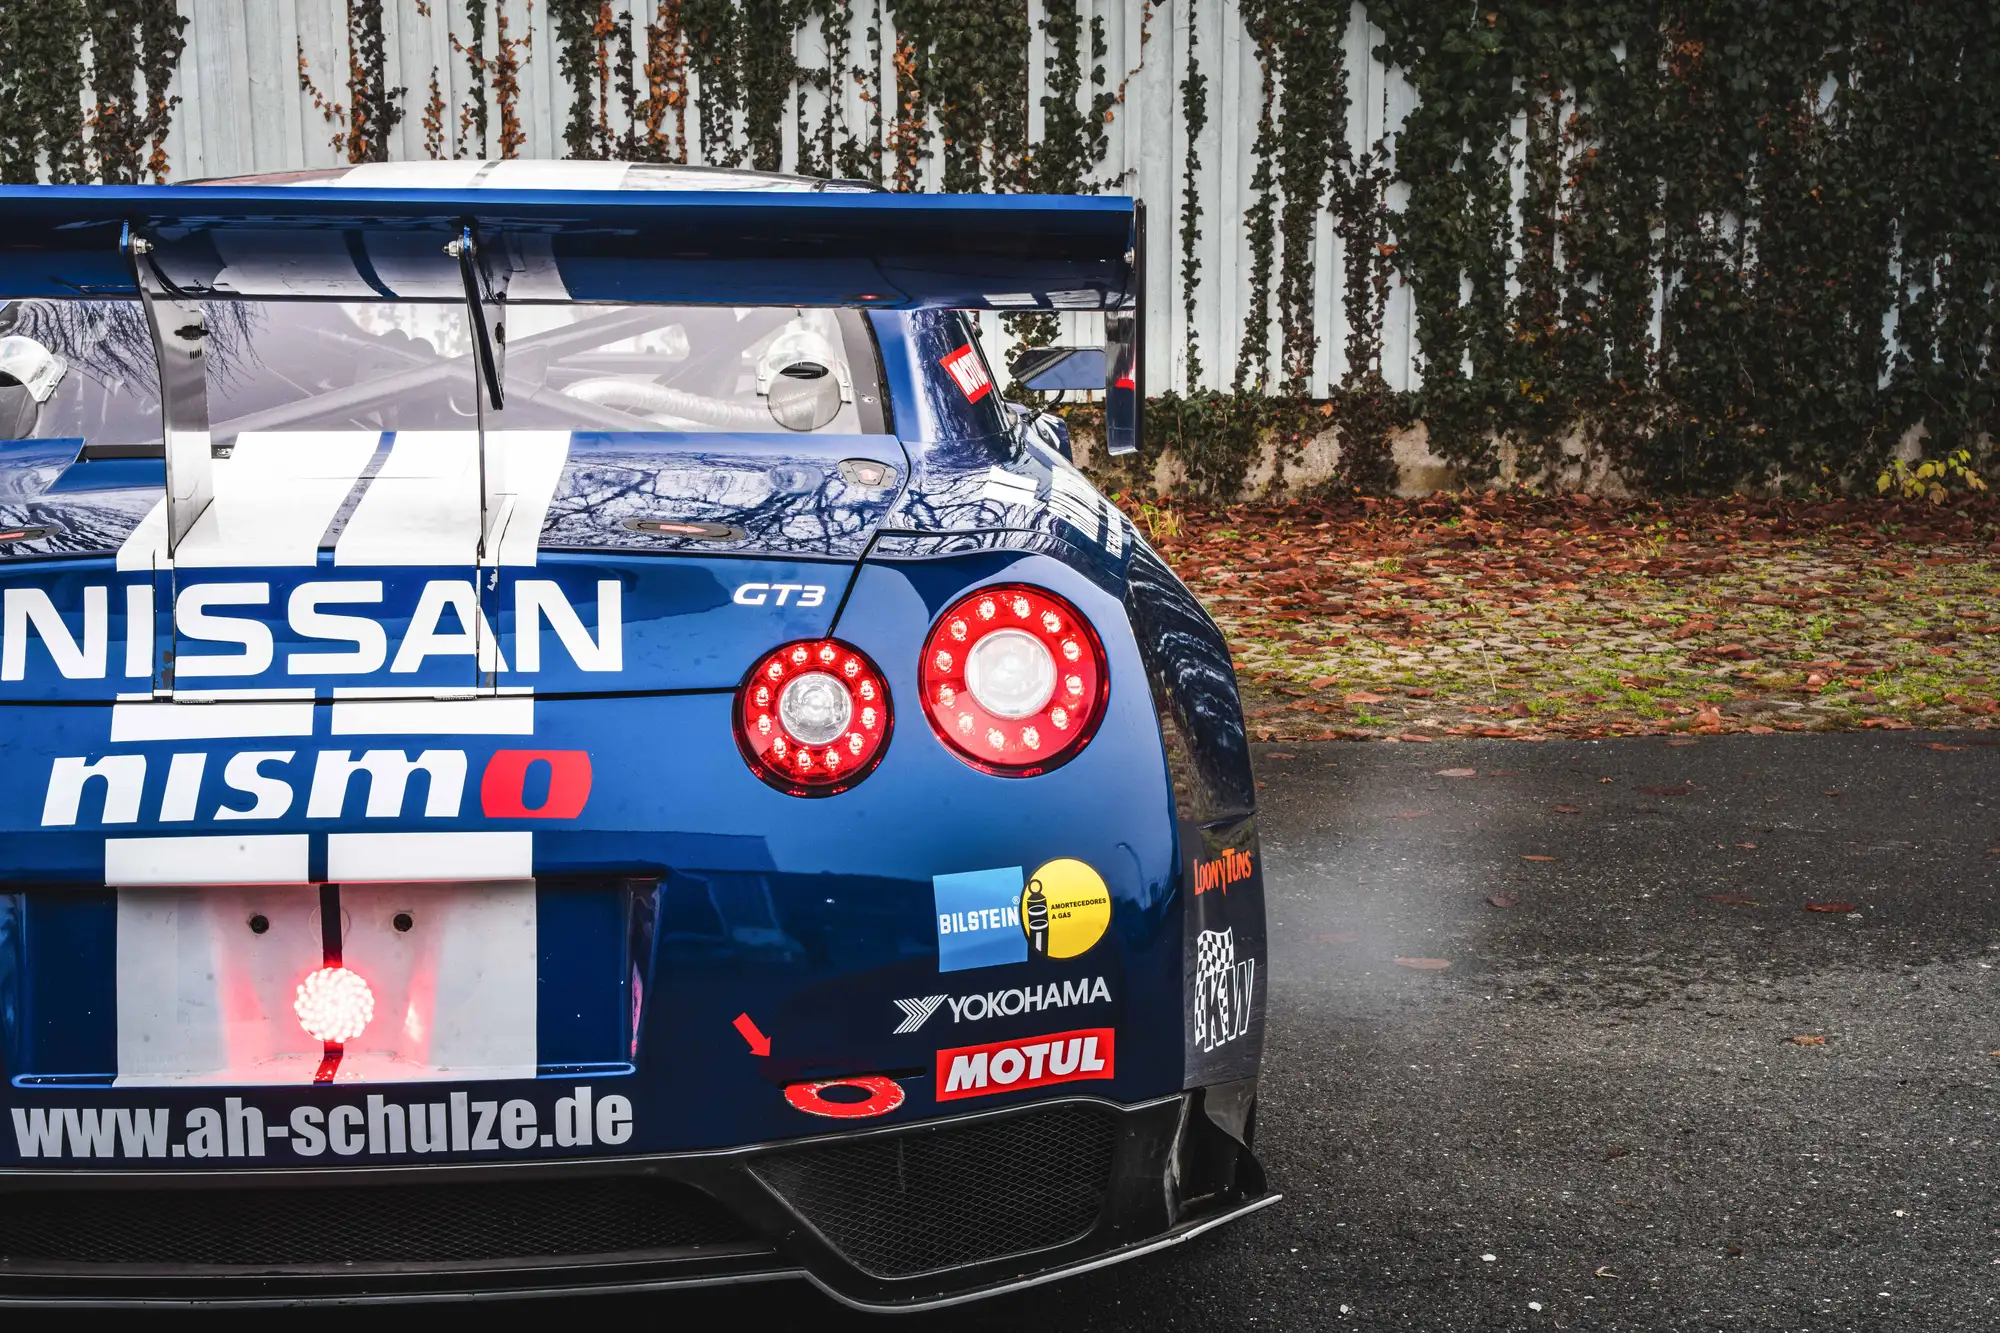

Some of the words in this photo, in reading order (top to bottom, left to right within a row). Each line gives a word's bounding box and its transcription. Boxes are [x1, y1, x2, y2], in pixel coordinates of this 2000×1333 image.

[733, 583, 826, 607] GT3
[1, 580, 623, 681] NISSAN
[41, 749, 593, 826] nismo
[939, 906, 1020, 935] BILSTEIN
[1051, 897, 1107, 910] AMORTECEDORES
[947, 976, 1112, 1024] YOKOHAMA
[1203, 957, 1255, 1053] KW
[945, 1036, 1105, 1093] MOTUL
[11, 1086, 633, 1158] www.ah-schulze.de
